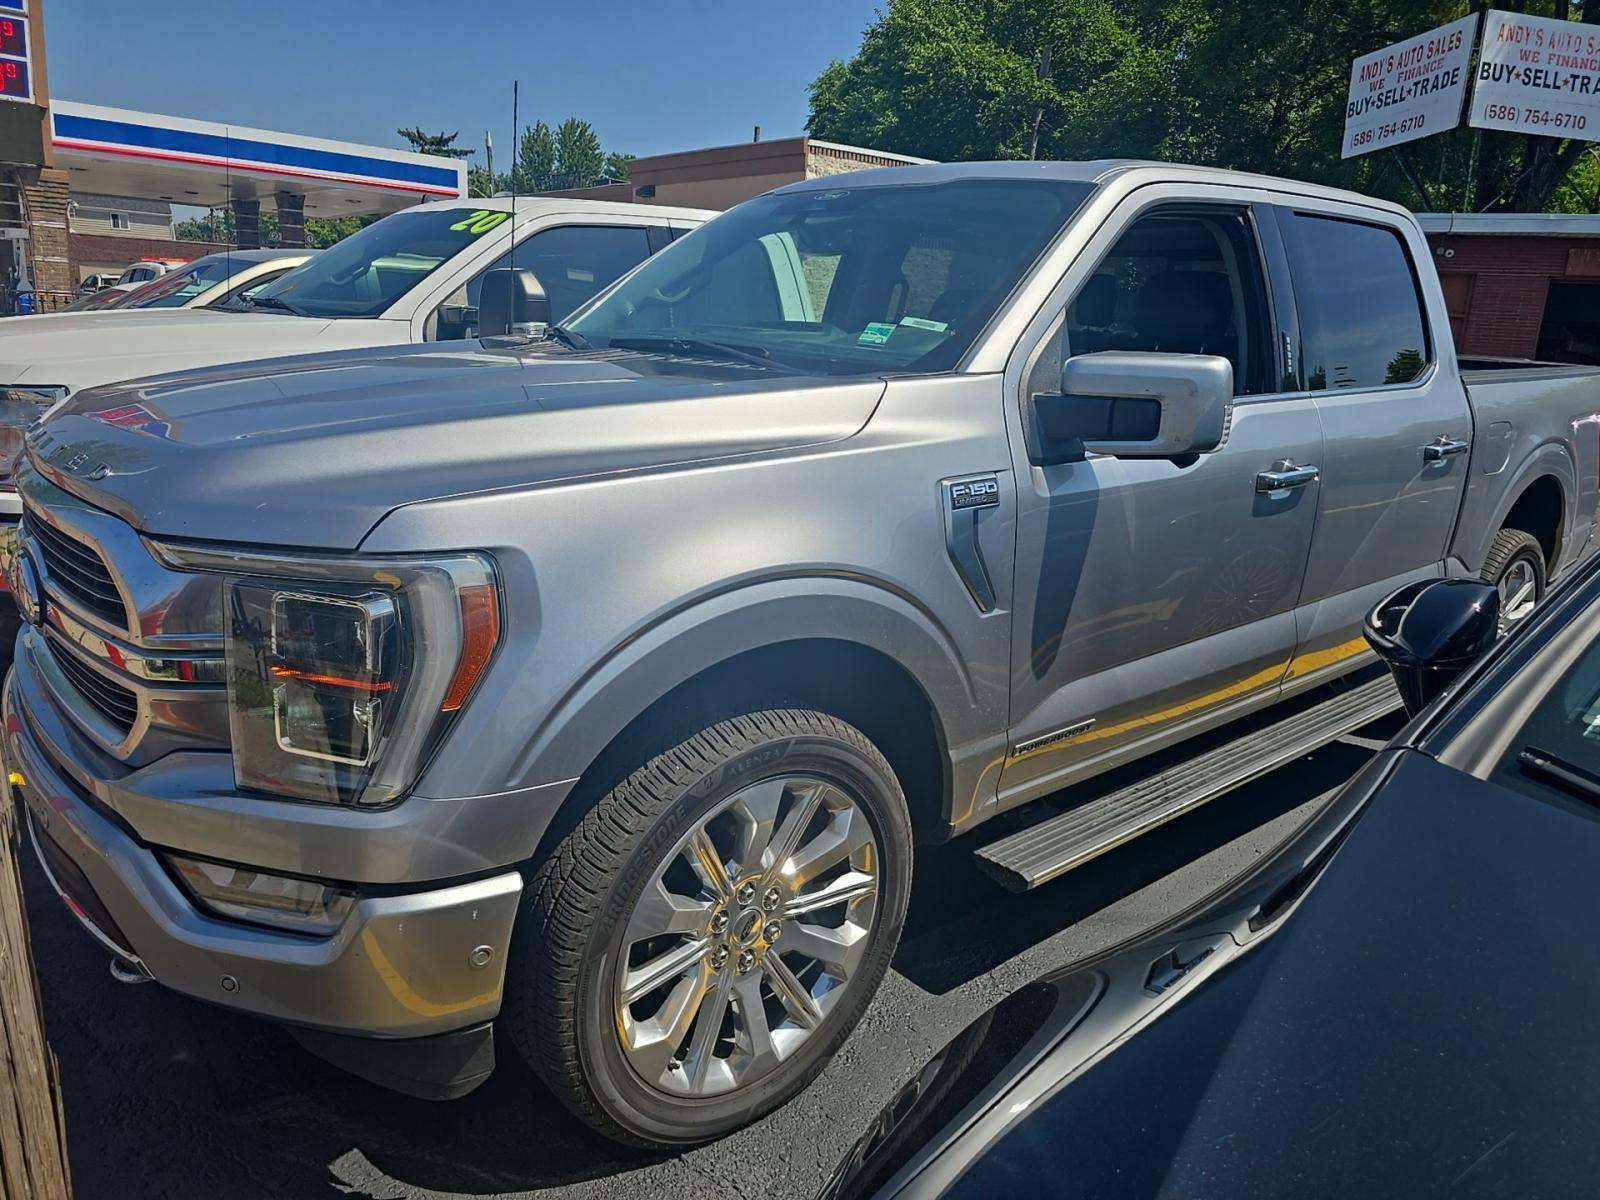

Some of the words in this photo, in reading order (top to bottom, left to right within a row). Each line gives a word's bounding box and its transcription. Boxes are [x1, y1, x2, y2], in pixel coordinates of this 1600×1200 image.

[1498, 23, 1543, 47] ANDY'S
[1549, 31, 1582, 53] AUTO
[1359, 55, 1394, 83] ANDY'S
[1397, 44, 1424, 70] AUTO
[1427, 30, 1463, 59] SALES
[1520, 48, 1541, 63] WE
[1369, 79, 1385, 92] WE
[1396, 57, 1445, 84] FINANCE
[1480, 61, 1517, 84] BUY
[1521, 67, 1561, 90] SELL
[1347, 95, 1373, 118] BUY
[1375, 85, 1406, 110] SELL
[1412, 66, 1461, 98] TRADE
[1484, 104, 1520, 124] (586)
[1523, 108, 1587, 130] 754-6710
[1350, 129, 1376, 150] (586)
[1378, 114, 1425, 140] 754-6710
[450, 210, 507, 234] 20
[952, 481, 998, 498] F-150
